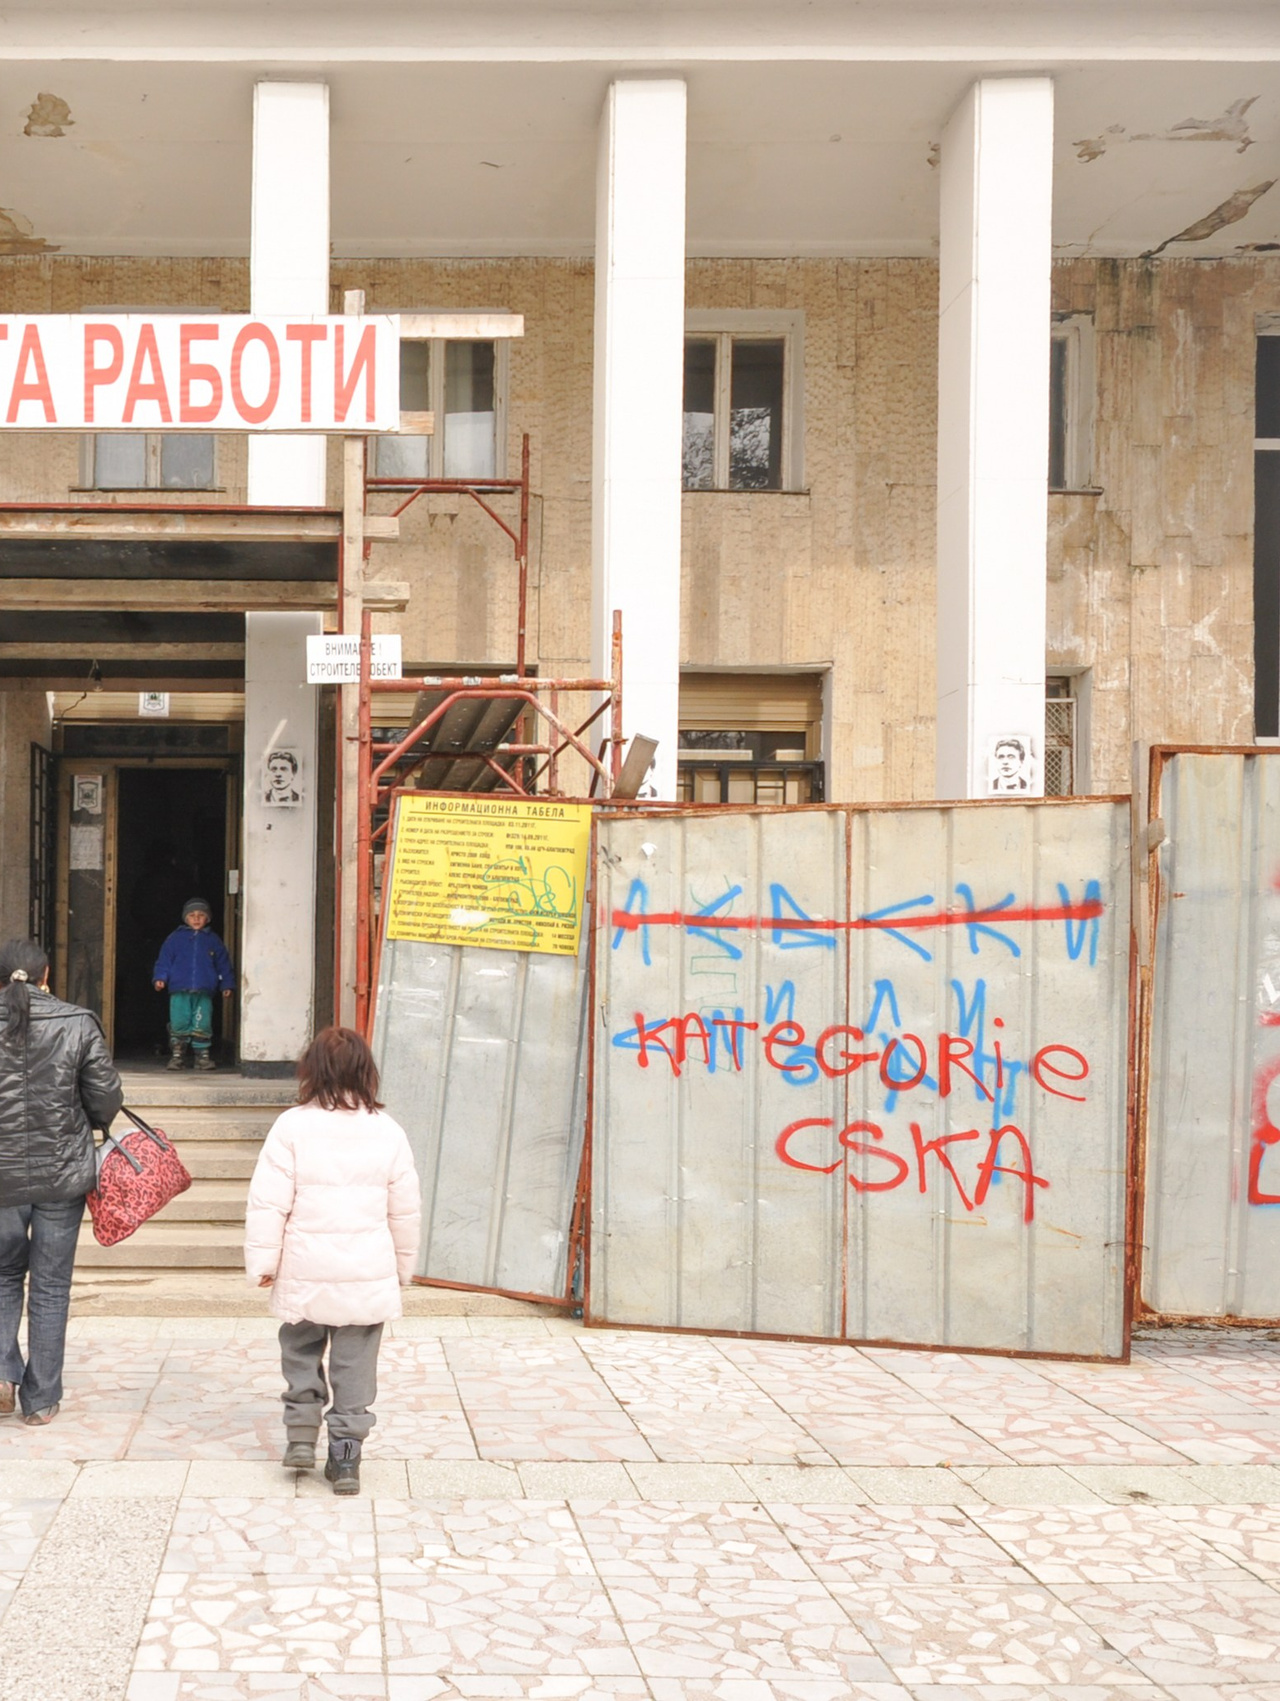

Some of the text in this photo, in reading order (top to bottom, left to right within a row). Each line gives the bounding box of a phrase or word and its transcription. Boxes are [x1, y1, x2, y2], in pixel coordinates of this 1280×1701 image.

[84, 321, 377, 424] РАБОТИ
[310, 662, 362, 676] СТРОИТЕЛЕ
[425, 800, 565, 818] ИНФОРМАЦИОННА ТАБЕЛА
[775, 1117, 1050, 1225] CSKA
